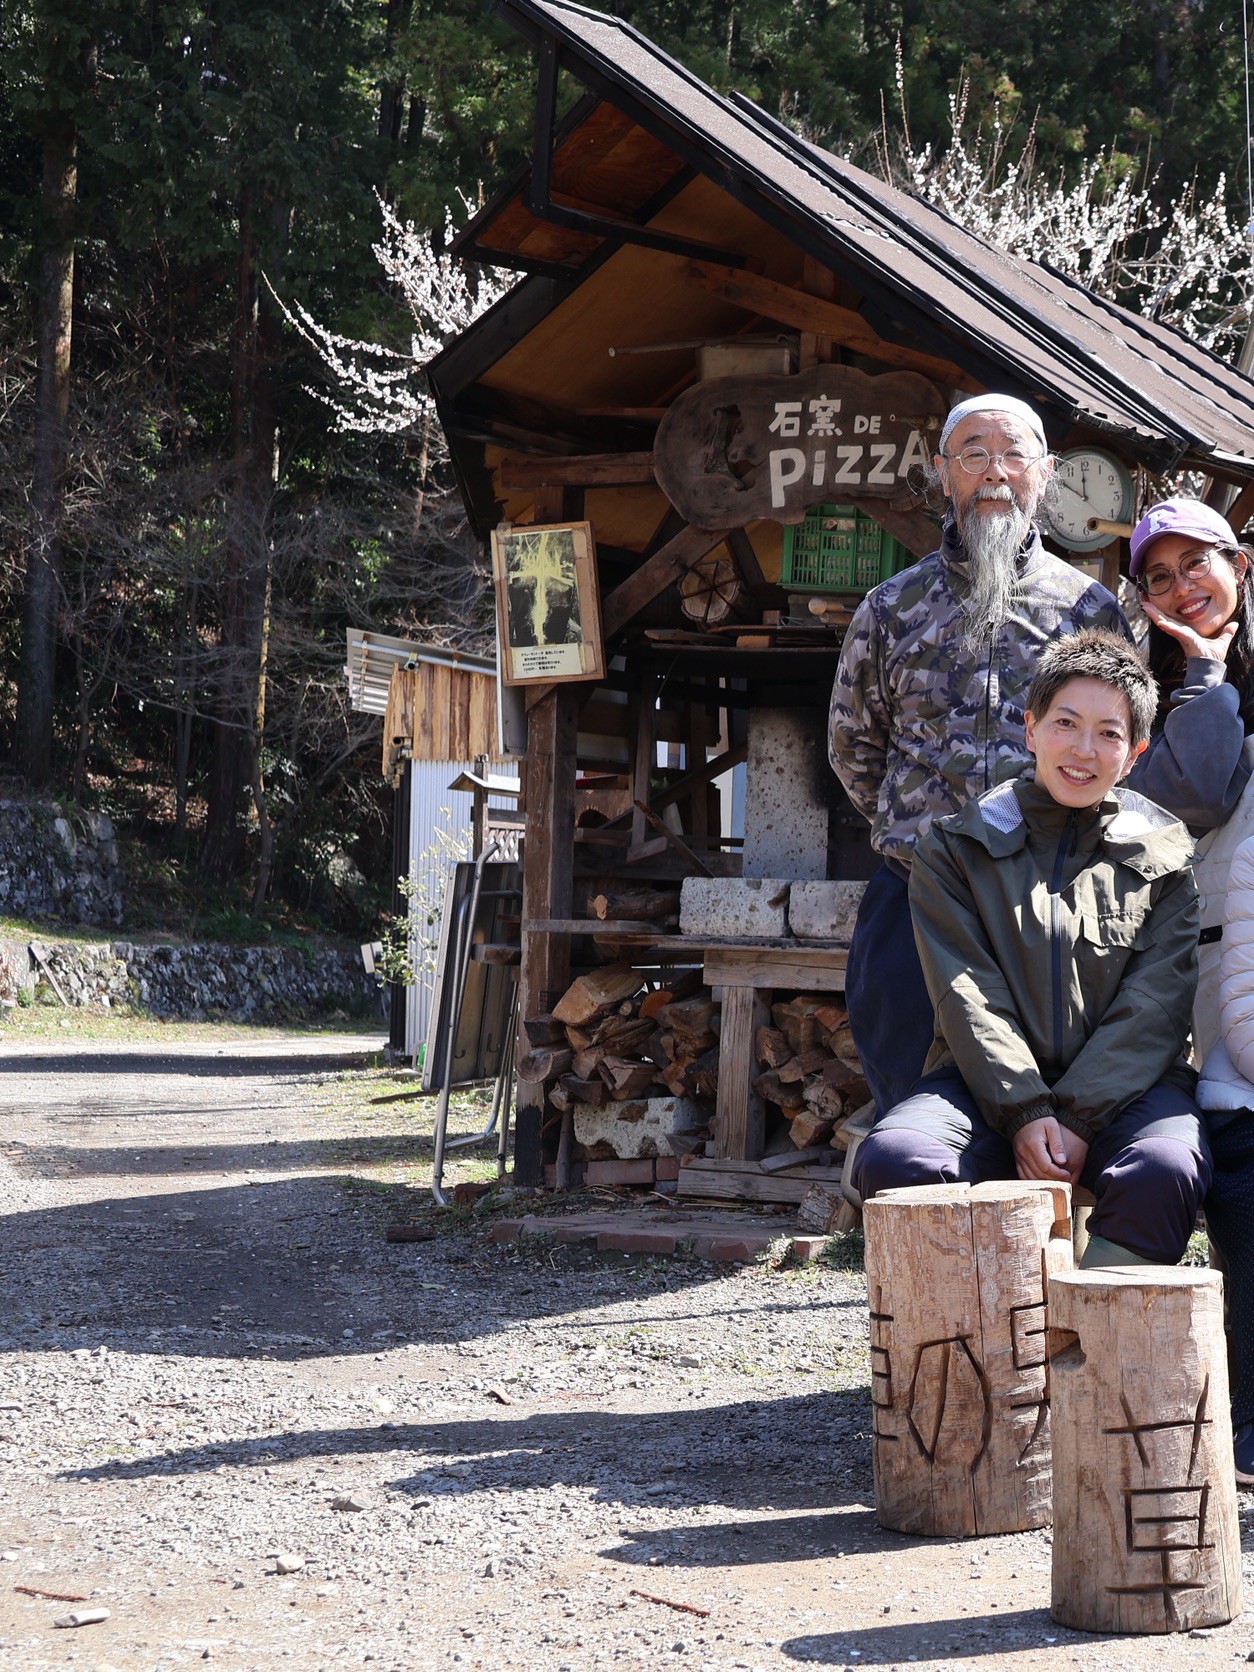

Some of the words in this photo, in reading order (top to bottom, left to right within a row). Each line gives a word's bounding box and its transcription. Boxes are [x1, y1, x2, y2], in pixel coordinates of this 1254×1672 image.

[768, 394, 843, 437] 石窯
[854, 415, 881, 434] DE
[1108, 475, 1115, 485] 2
[1113, 491, 1120, 501] 3
[1057, 512, 1064, 522] 8
[1108, 508, 1115, 519] 4
[1068, 523, 1075, 532] 7
[1082, 526, 1090, 536] 6
